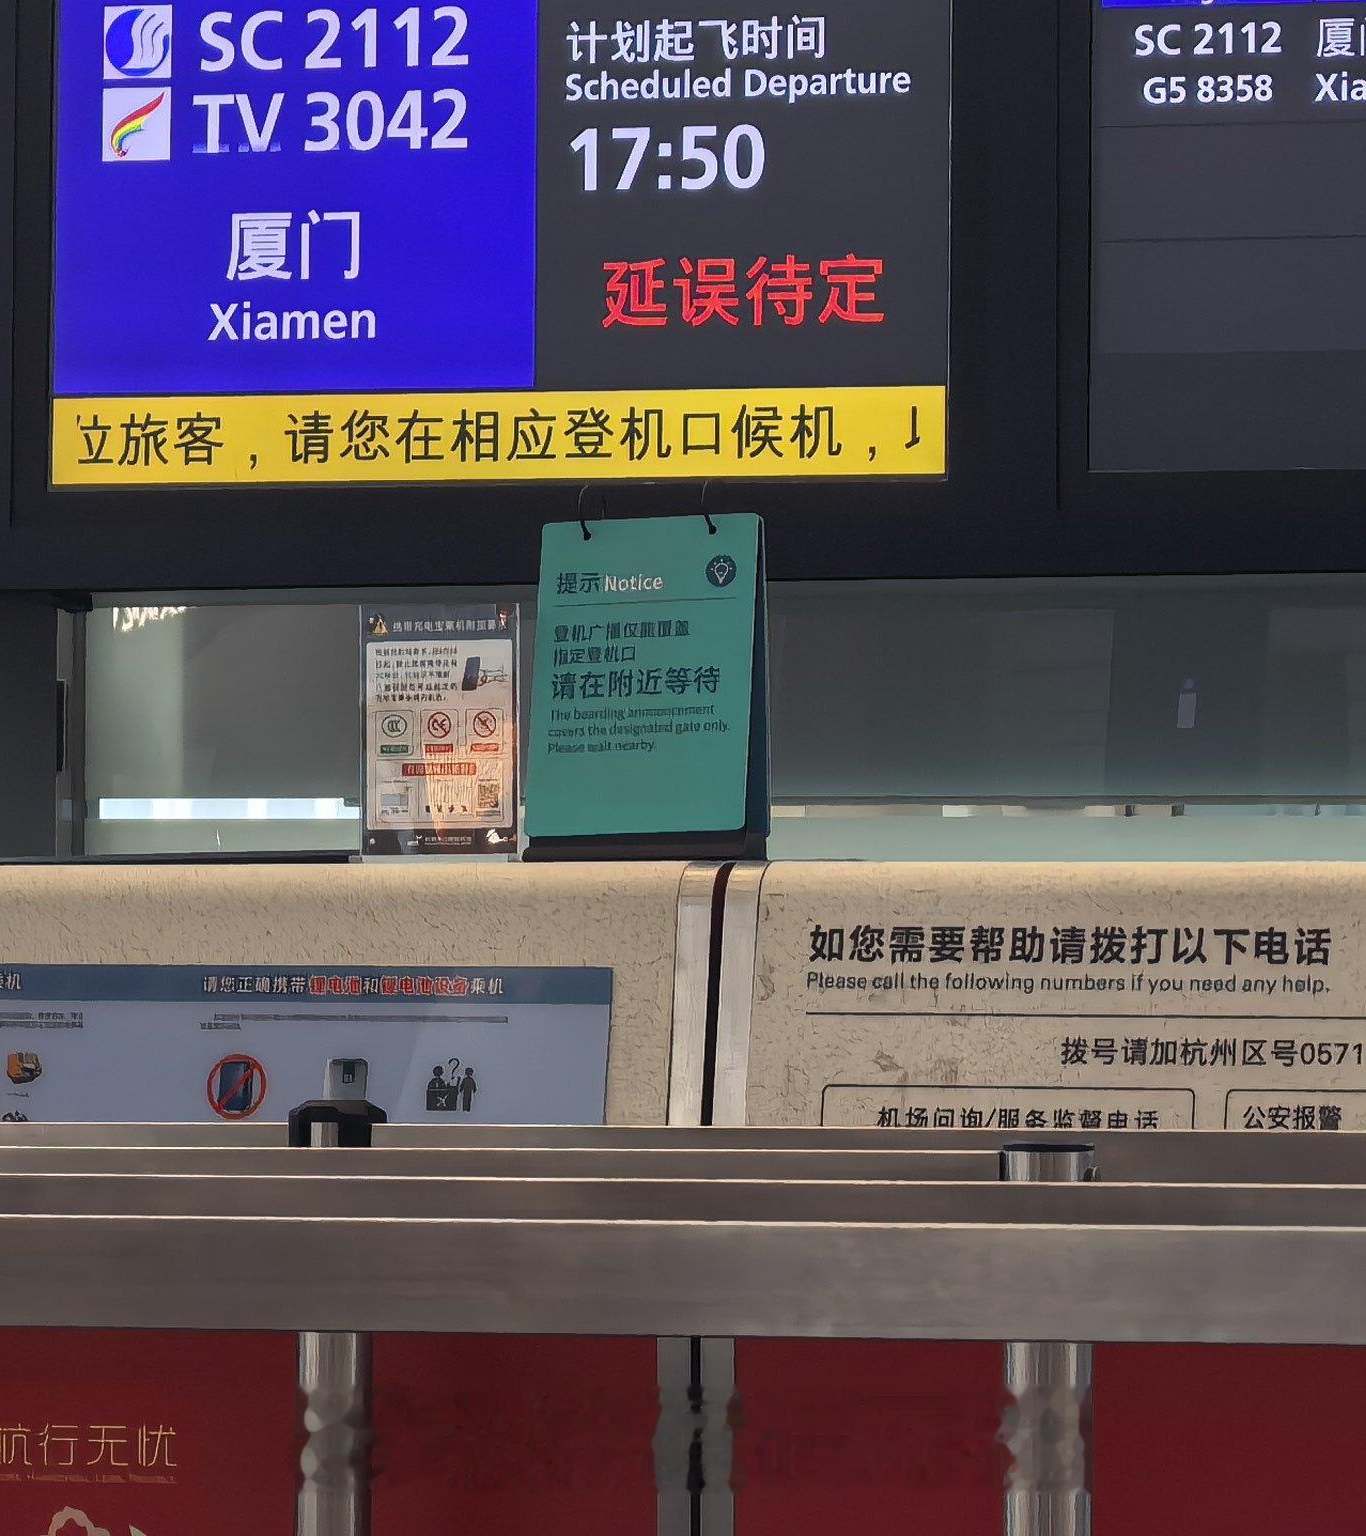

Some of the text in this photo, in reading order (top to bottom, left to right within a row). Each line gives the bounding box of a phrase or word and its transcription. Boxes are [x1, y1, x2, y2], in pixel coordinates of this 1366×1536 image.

[199, 6, 469, 72] SC 2112
[566, 16, 826, 65] 计划起飞时间
[1134, 21, 1283, 57] SC 2112
[565, 68, 911, 103] Scheduled Departure
[1143, 74, 1273, 104] G5 8358
[193, 89, 468, 153] TV 3042
[569, 123, 765, 192] 17:50
[226, 211, 361, 283] 厦门
[602, 254, 885, 328] 延误待定
[207, 302, 377, 342] Xiamen
[556, 572, 664, 595] 提示 Notice
[552, 665, 720, 700] 请在附近等待
[809, 925, 1331, 966] 如您需要帮助请拨打以下电话
[807, 971, 867, 993] Please
[871, 973, 904, 992] call
[910, 973, 939, 992] the
[945, 972, 1034, 995] following
[1040, 973, 1125, 992] numbers
[1130, 973, 1144, 992] if
[1148, 977, 1184, 996] you
[1189, 973, 1236, 993] need
[1241, 978, 1276, 996] any
[1060, 1037, 1364, 1067] 拨号请加杭州区号0571
[1243, 1104, 1342, 1132] 公安报警
